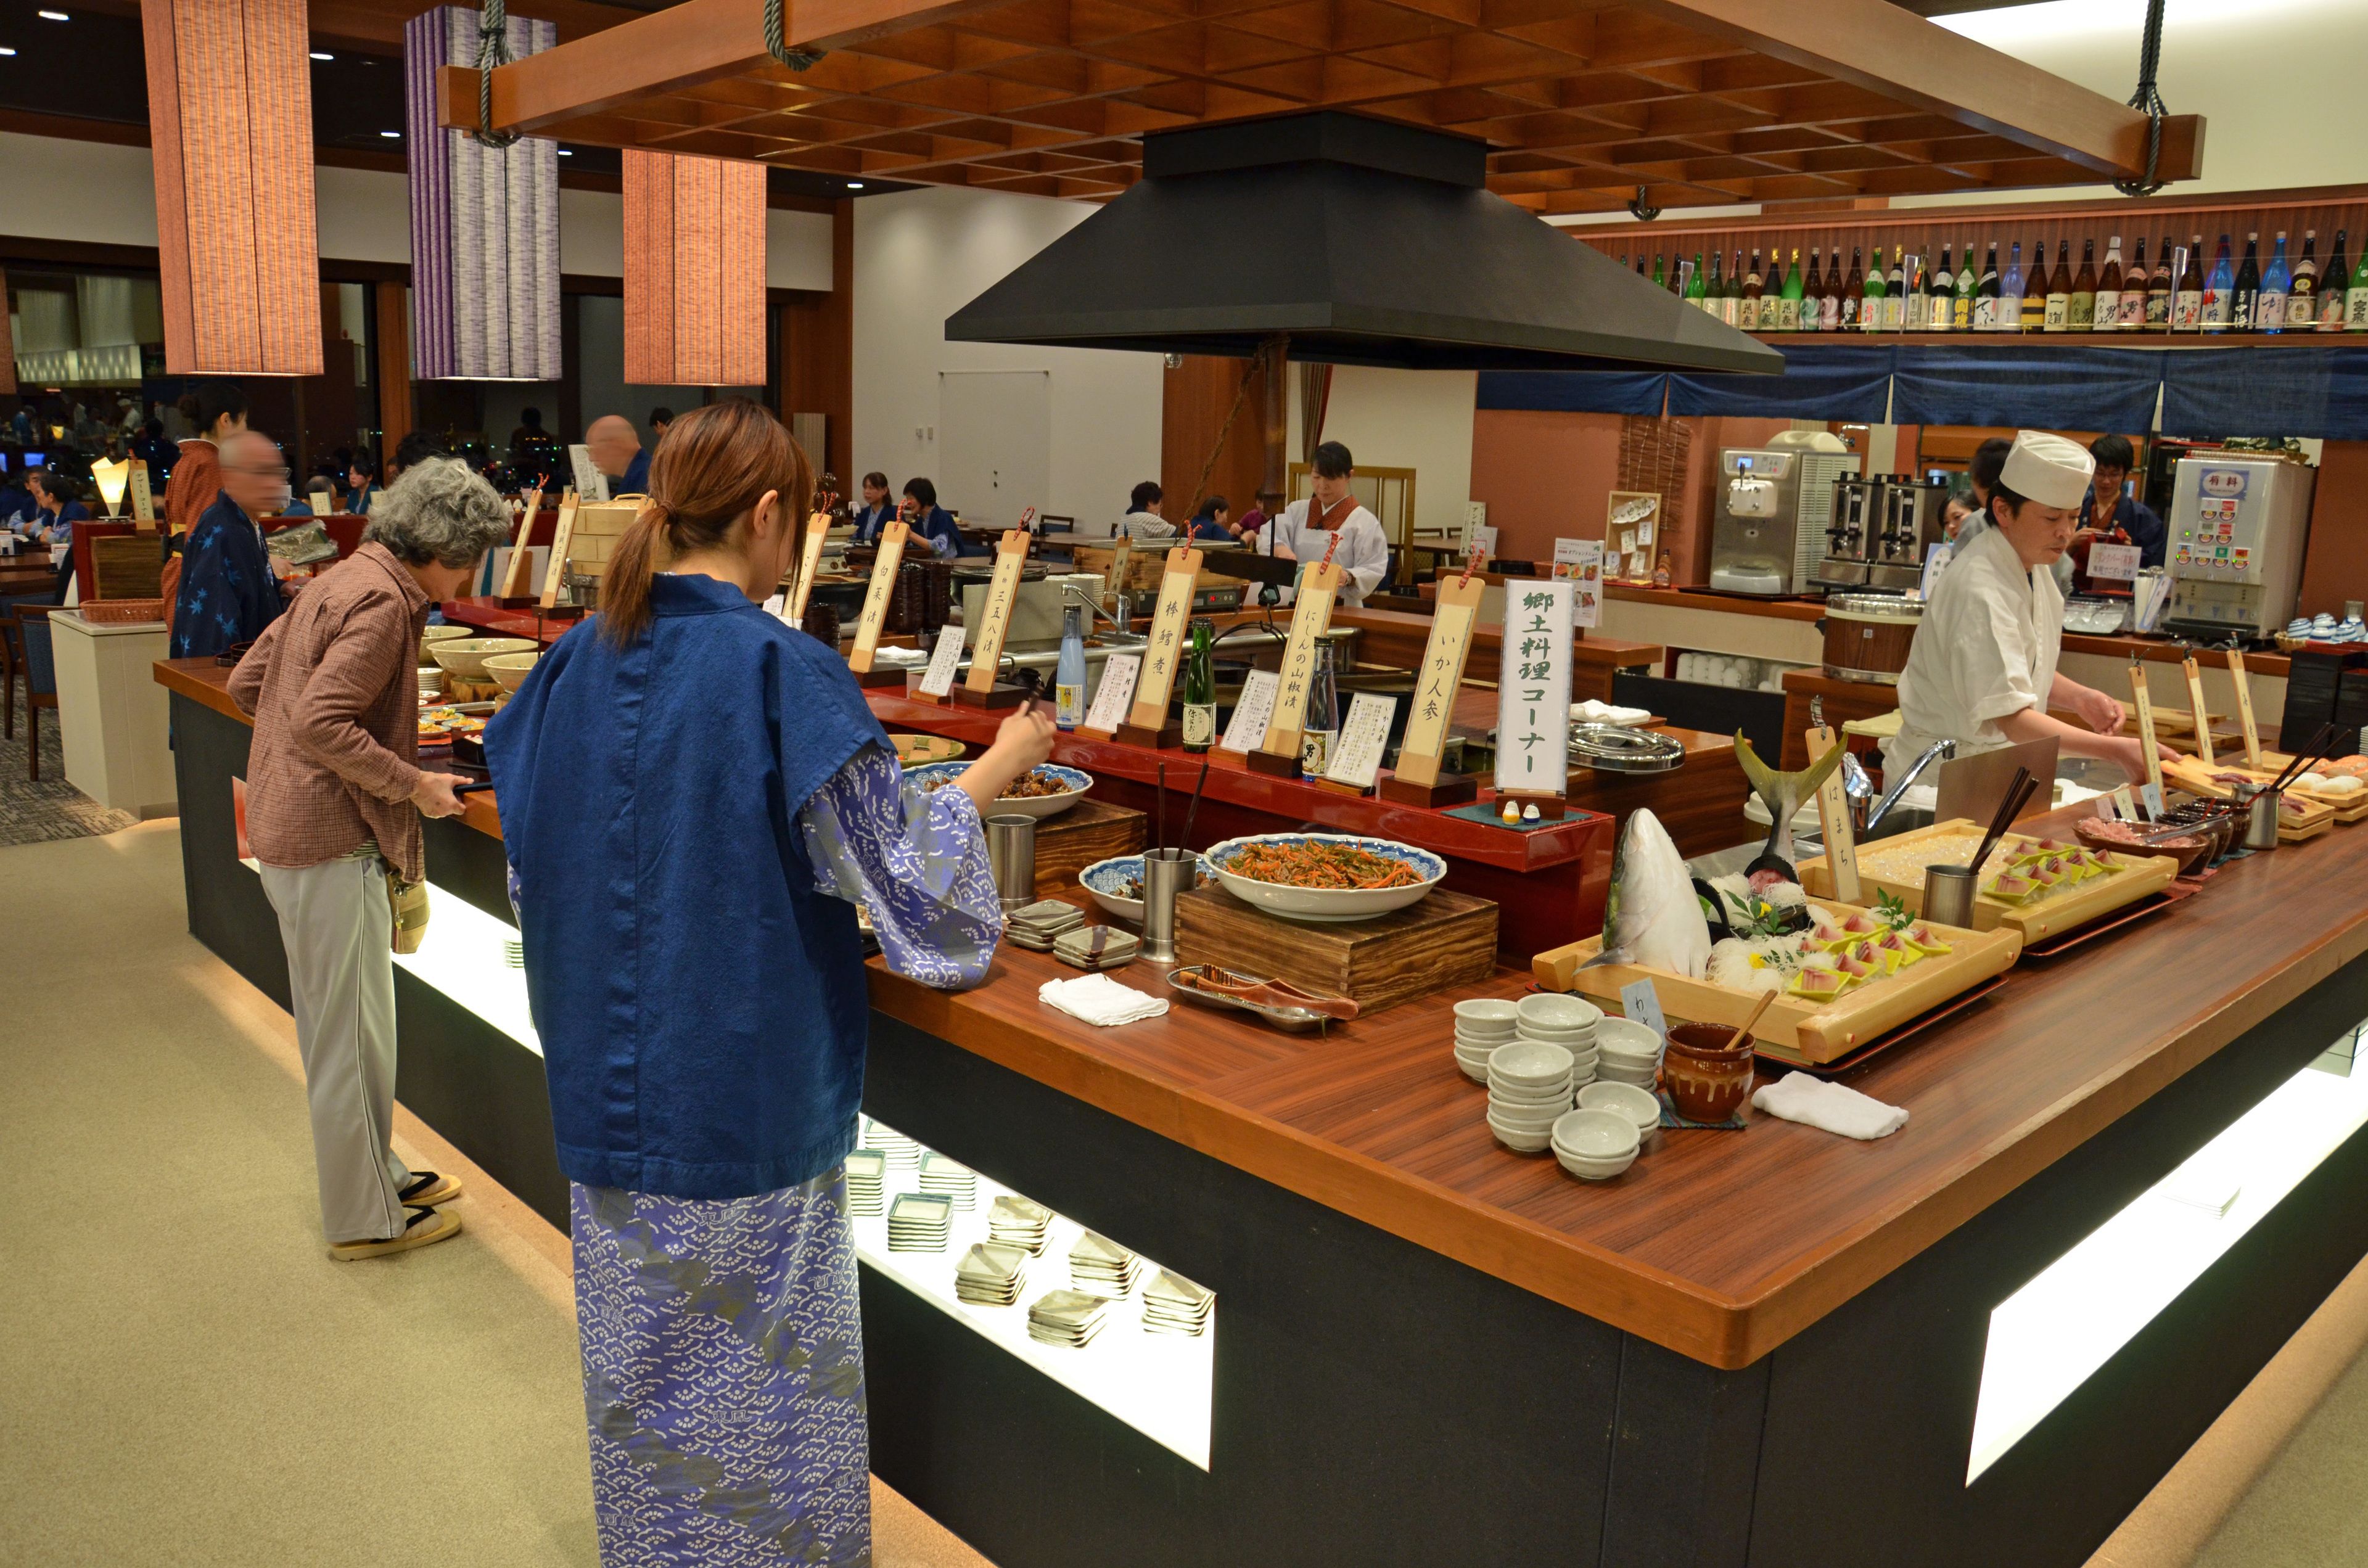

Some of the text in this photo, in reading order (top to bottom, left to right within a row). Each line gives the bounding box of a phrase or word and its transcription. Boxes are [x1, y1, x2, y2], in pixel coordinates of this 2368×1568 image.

[867, 565, 889, 624] 白菜漬
[1153, 601, 1178, 675] 棒鱈煮
[1285, 610, 1317, 708] にしんの山椒漬
[1423, 636, 1455, 720] いか人参
[1518, 592, 1554, 773] 郷土料理コーナー
[1829, 786, 1848, 867] はまち
